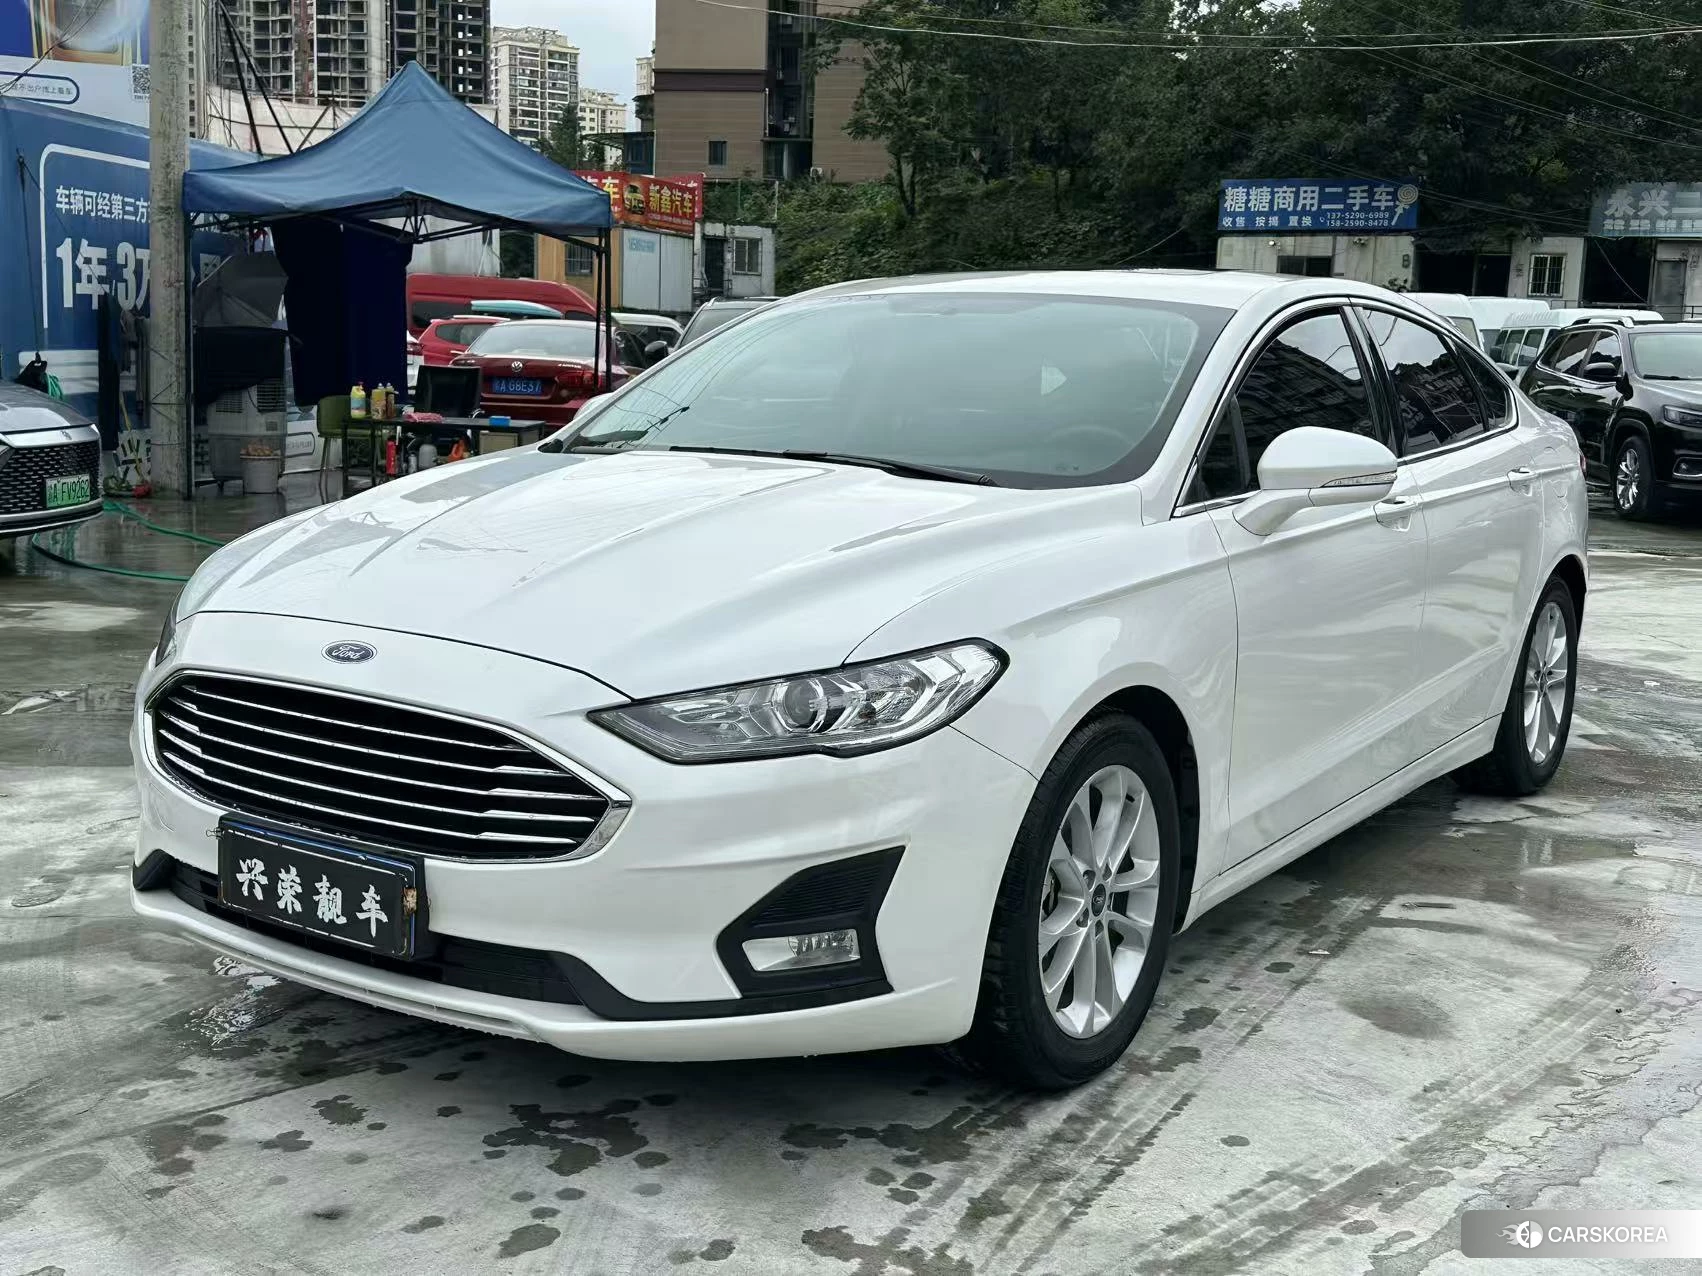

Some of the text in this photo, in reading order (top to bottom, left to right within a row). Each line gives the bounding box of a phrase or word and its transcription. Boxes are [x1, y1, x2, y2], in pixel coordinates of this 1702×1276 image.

[56, 185, 150, 224] 车辆可经第三方
[1224, 184, 1394, 212] 糖糖商用二手车
[1287, 215, 1313, 227] 置换
[236, 857, 388, 938] 兴荣靓车
